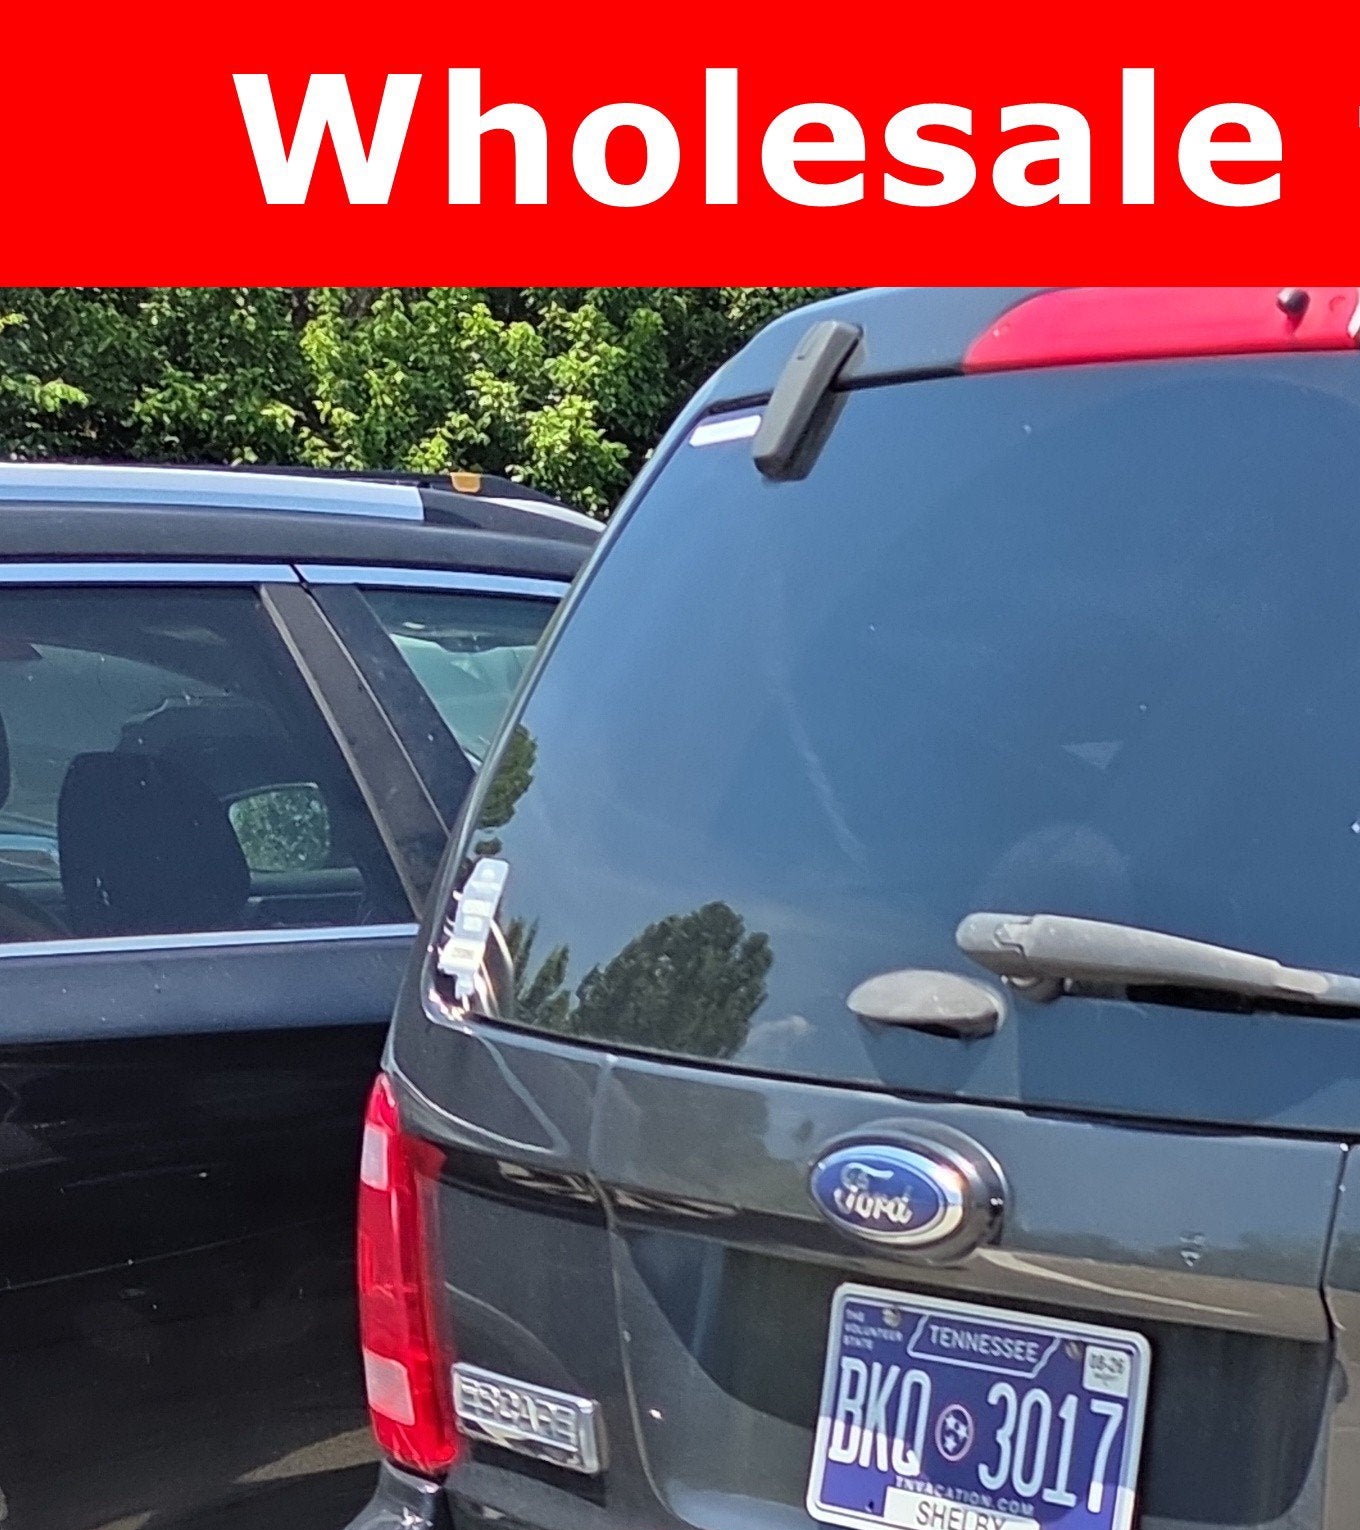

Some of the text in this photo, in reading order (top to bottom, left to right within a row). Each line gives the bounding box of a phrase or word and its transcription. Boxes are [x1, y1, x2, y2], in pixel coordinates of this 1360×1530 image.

[833, 1162, 914, 1224] Ford
[929, 1324, 1040, 1364] TENNESSEE
[459, 1374, 579, 1447] ESCAPE
[977, 1381, 1125, 1514] 3017
